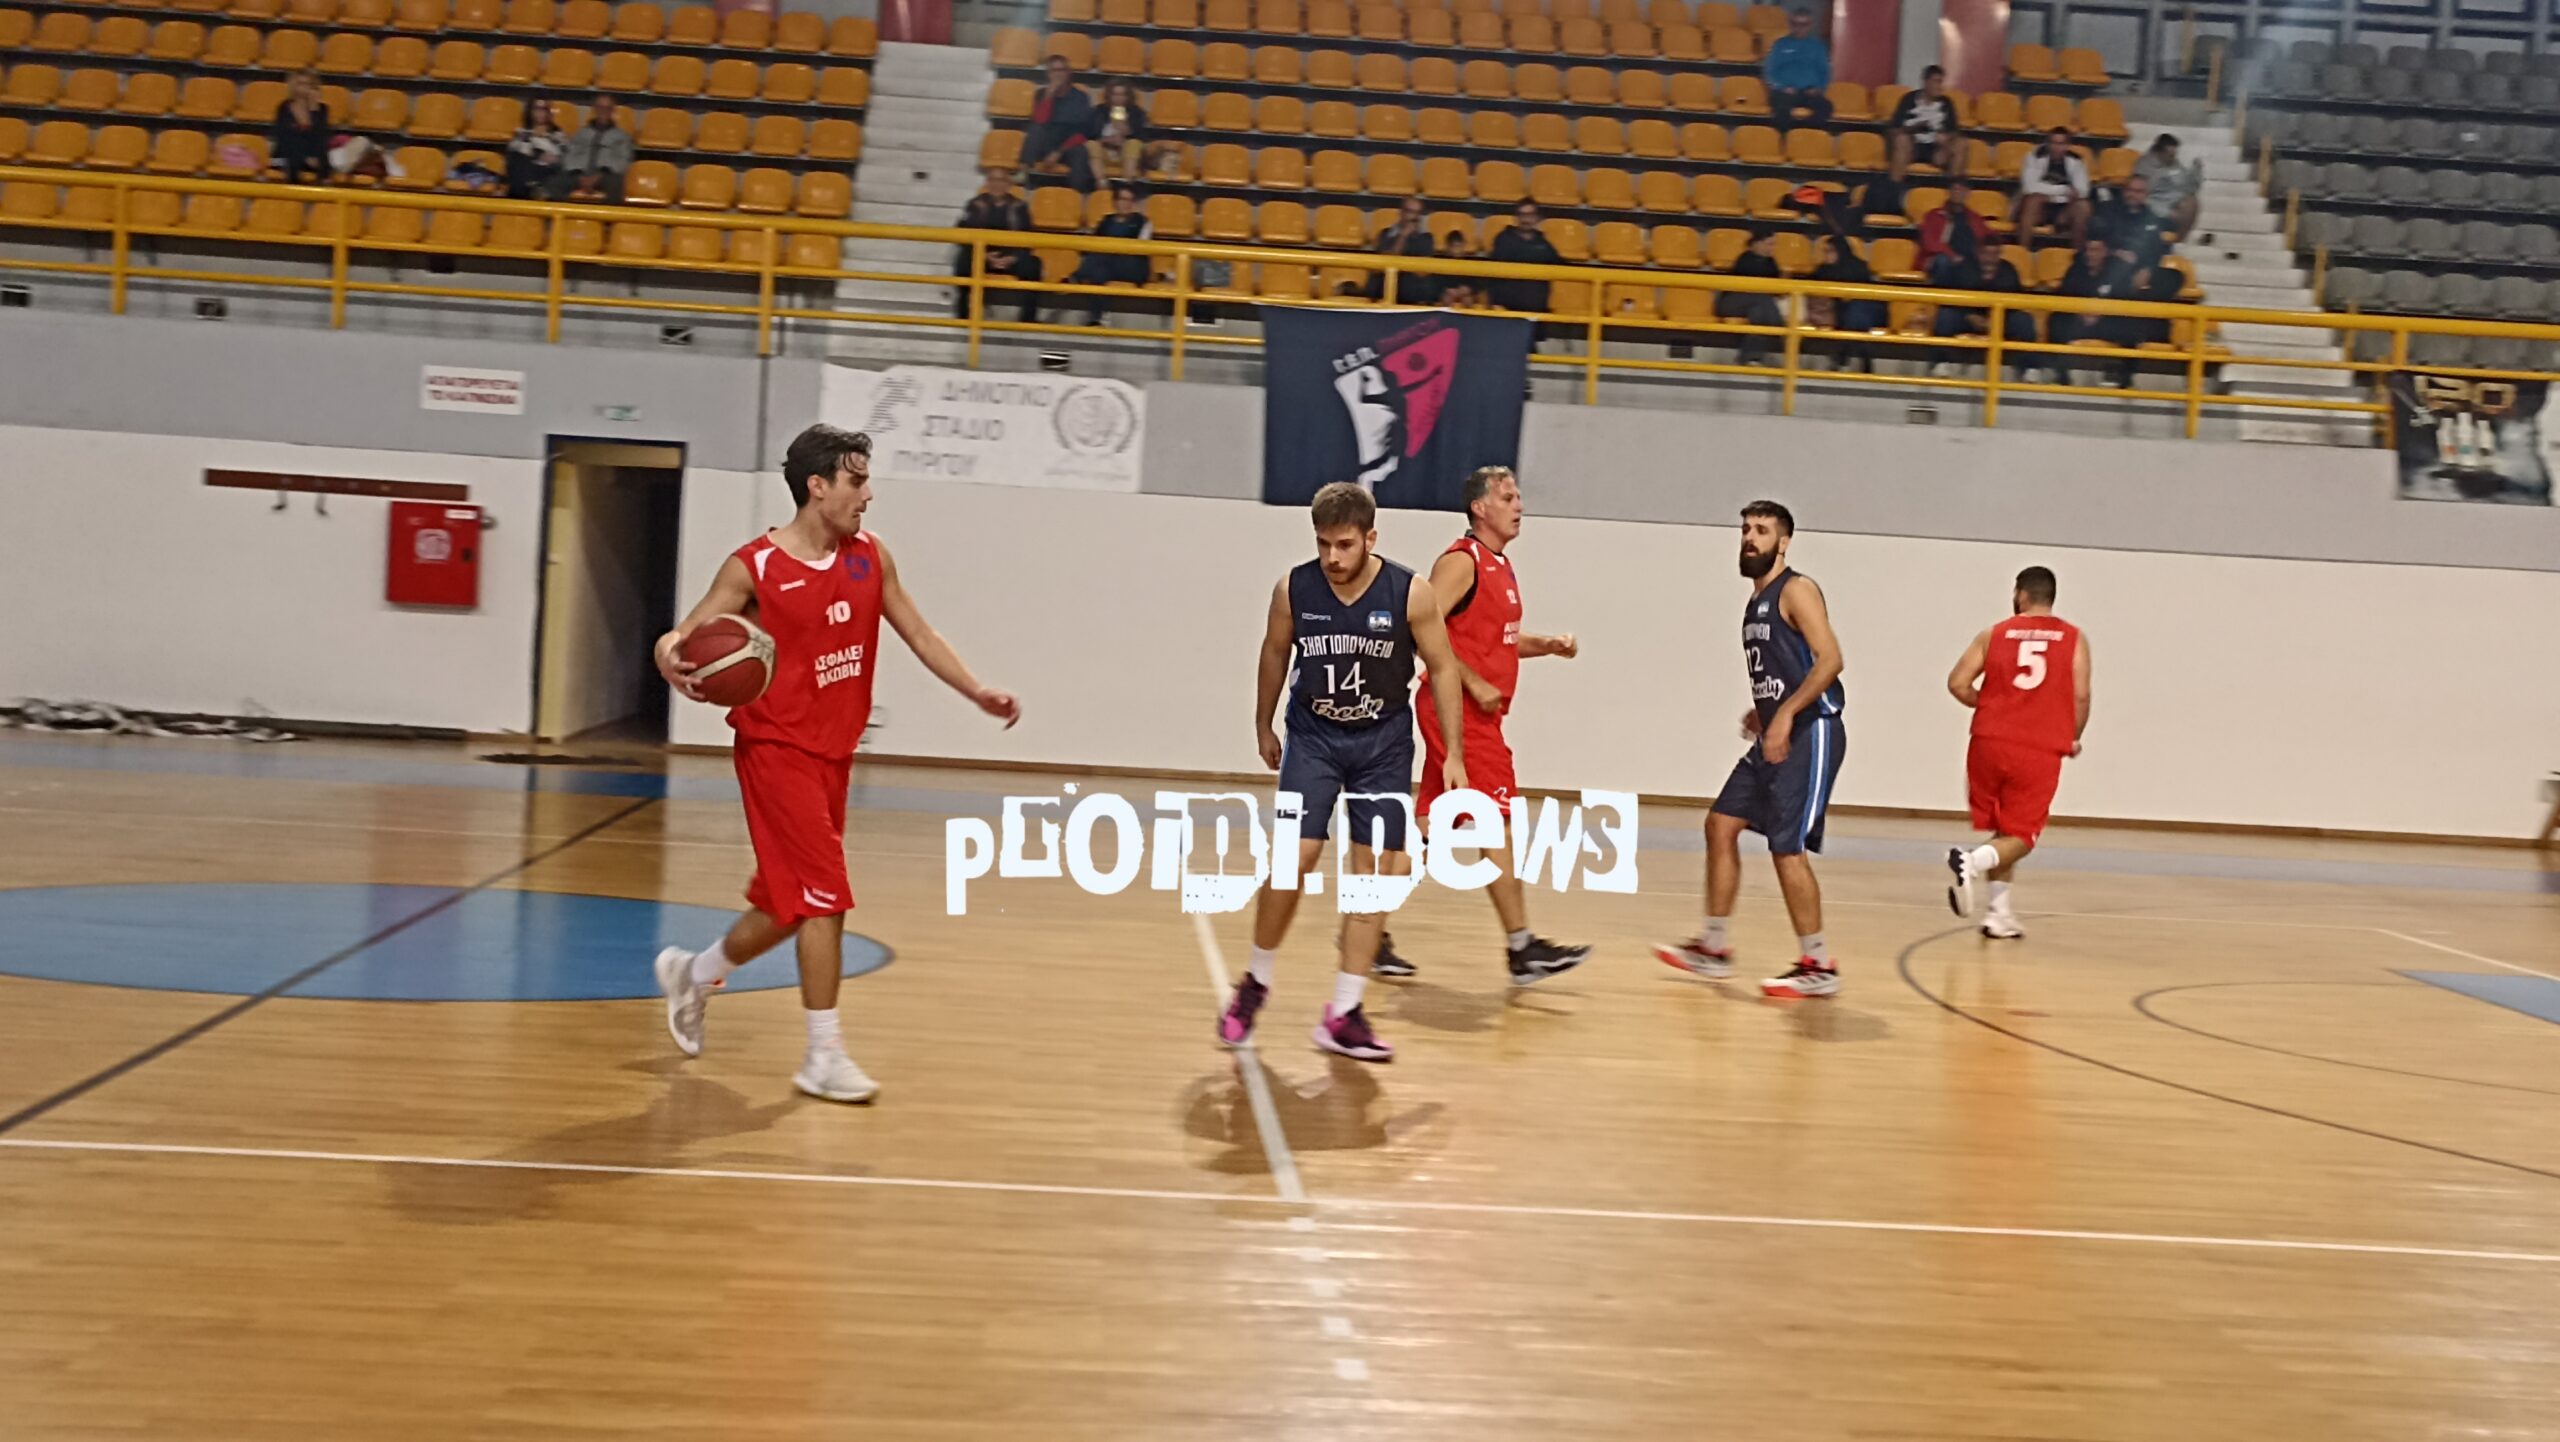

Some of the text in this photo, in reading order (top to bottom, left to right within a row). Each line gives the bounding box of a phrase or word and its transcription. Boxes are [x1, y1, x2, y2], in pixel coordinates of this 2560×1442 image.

[921, 414, 1005, 442] ΣΤΑΔΙΟ
[825, 600, 851, 626] 10
[1323, 661, 1367, 697] 14
[2012, 640, 2049, 691] 5
